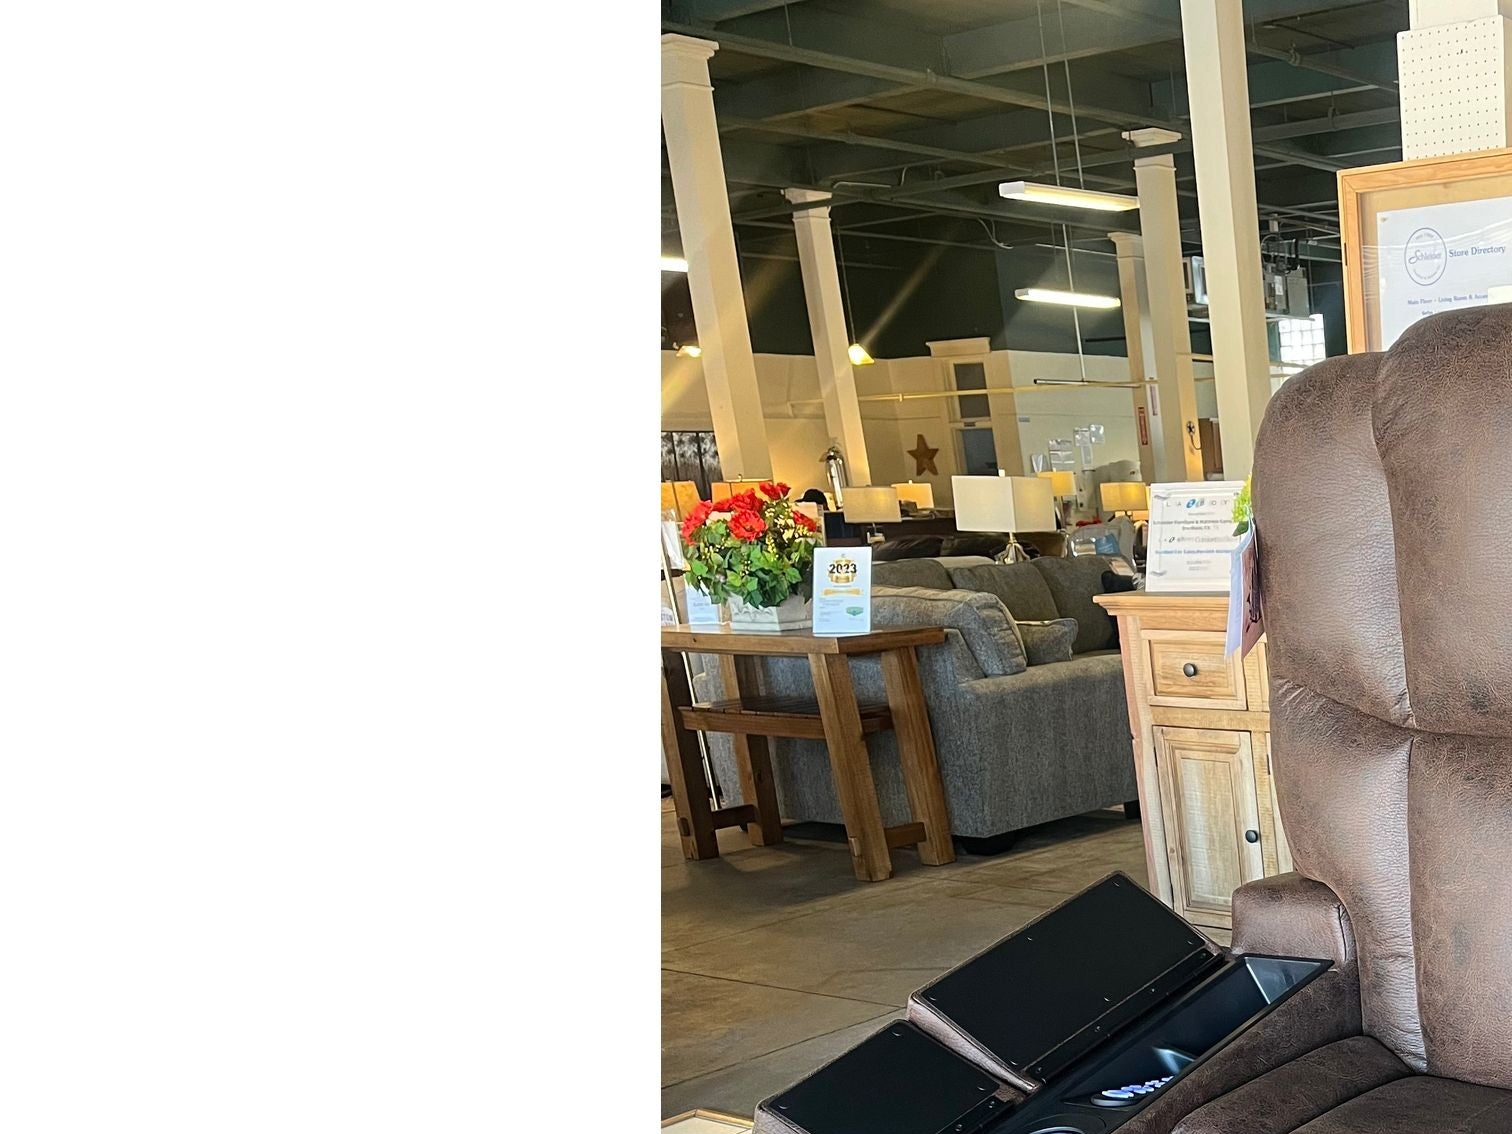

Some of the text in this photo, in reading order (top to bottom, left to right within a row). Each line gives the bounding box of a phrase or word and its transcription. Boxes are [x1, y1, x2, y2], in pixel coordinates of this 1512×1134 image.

[1448, 245, 1506, 258] Store Directory
[828, 563, 857, 574] 2023
